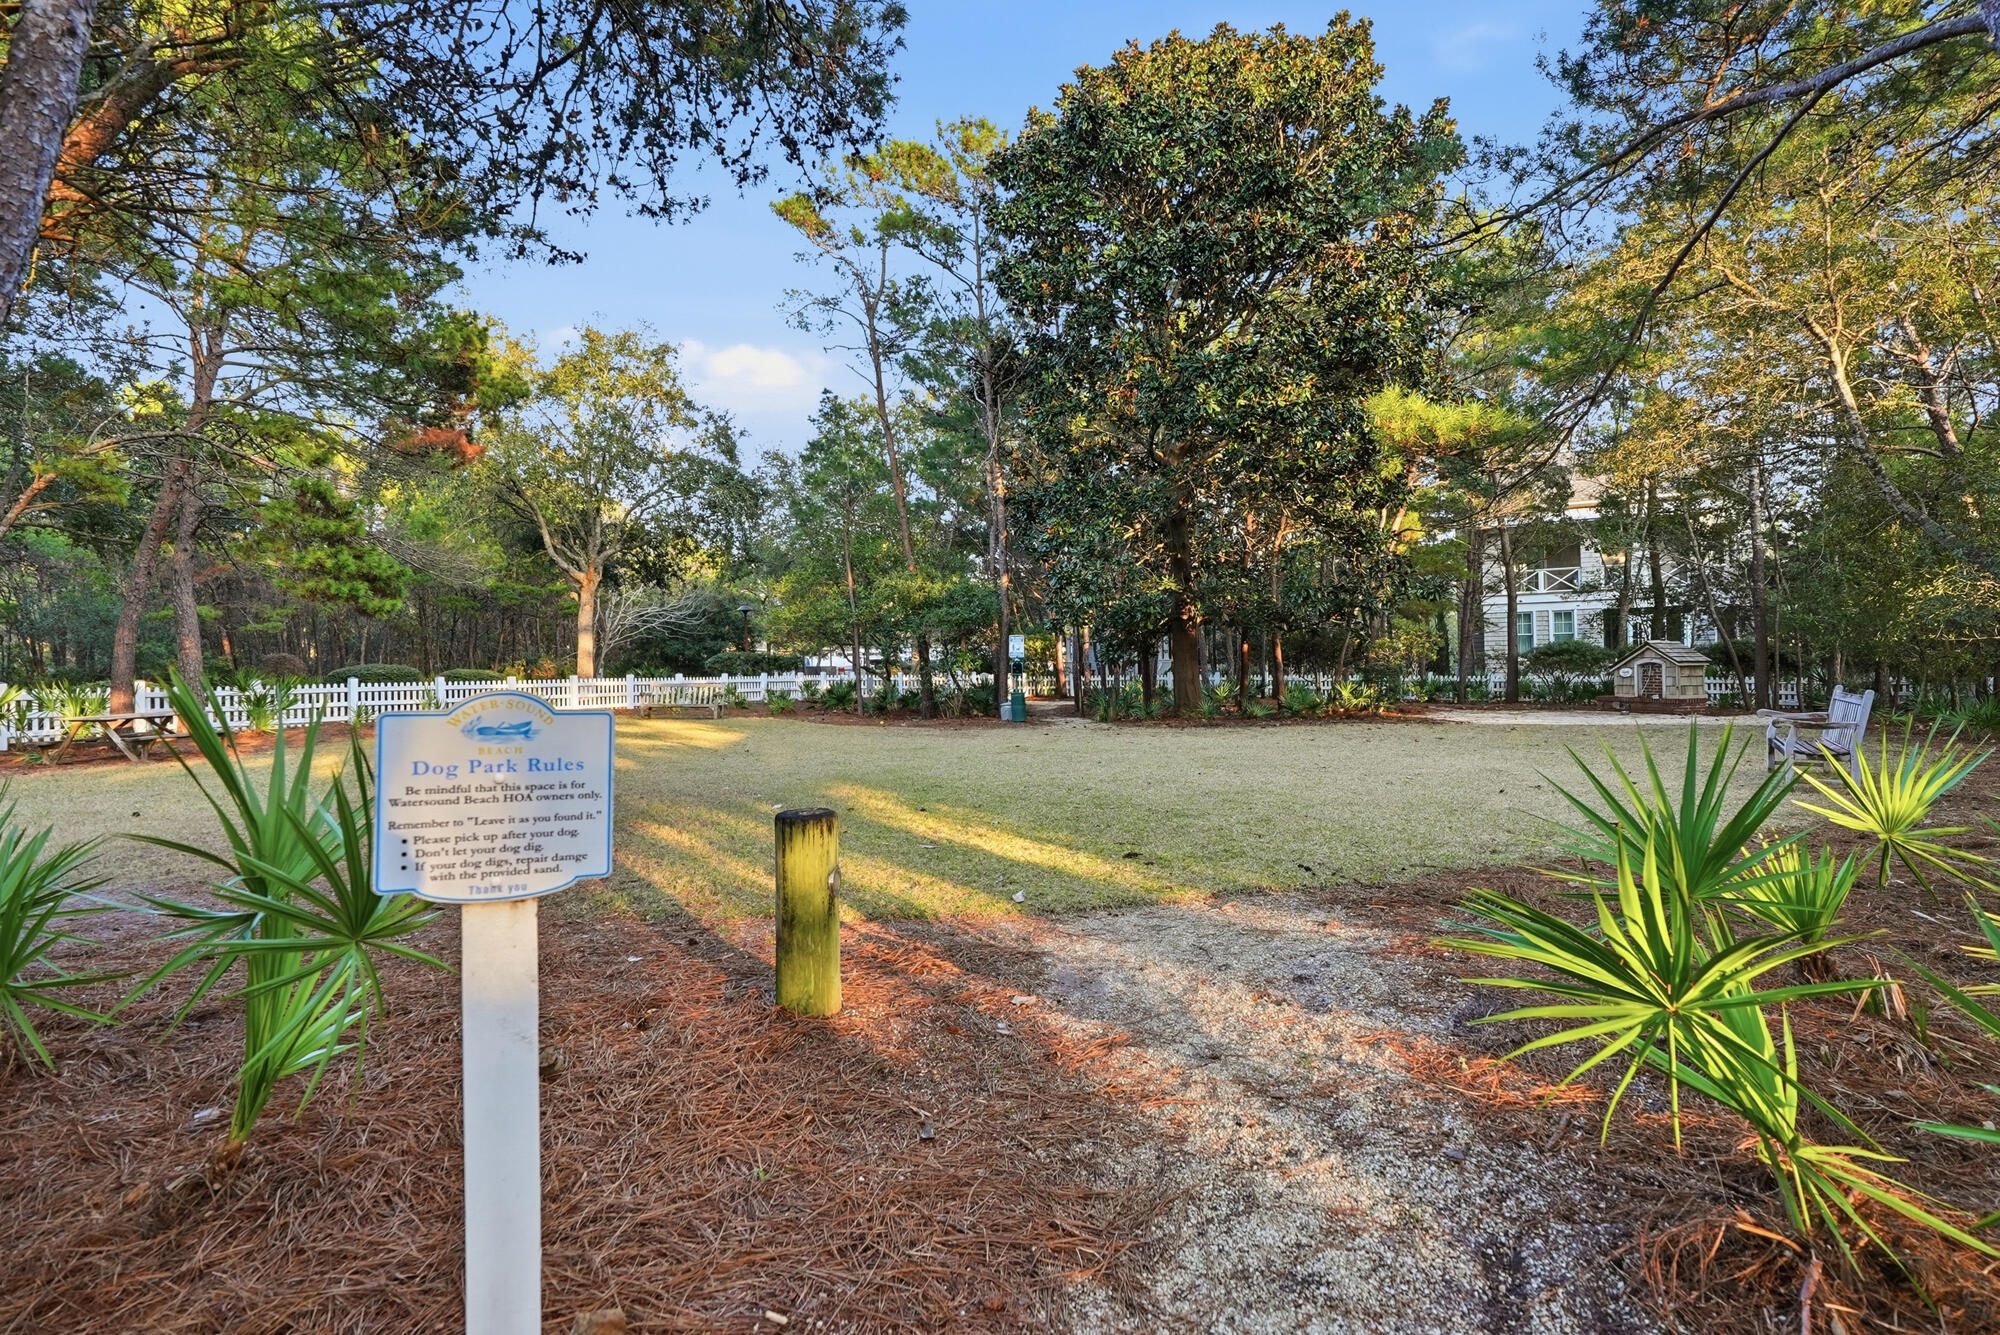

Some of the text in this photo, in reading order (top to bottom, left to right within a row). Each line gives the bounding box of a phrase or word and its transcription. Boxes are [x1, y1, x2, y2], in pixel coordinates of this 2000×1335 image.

[478, 746, 523, 755] BEACH
[412, 757, 585, 780] Dog Park Rules
[405, 780, 586, 796] Be mindful that this space is for
[388, 790, 602, 807] Watersound Beach HOA owners only.
[388, 820, 450, 831] Remember
[508, 815, 516, 824] it
[533, 814, 551, 826] you
[554, 812, 584, 821] found
[413, 827, 580, 845] Please pick up after your dog.
[415, 842, 544, 858] Don't let your dog dig.
[415, 853, 588, 873] If your dog digs, repair damge
[430, 863, 563, 881] with the provided sand.
[507, 883, 528, 893] you
